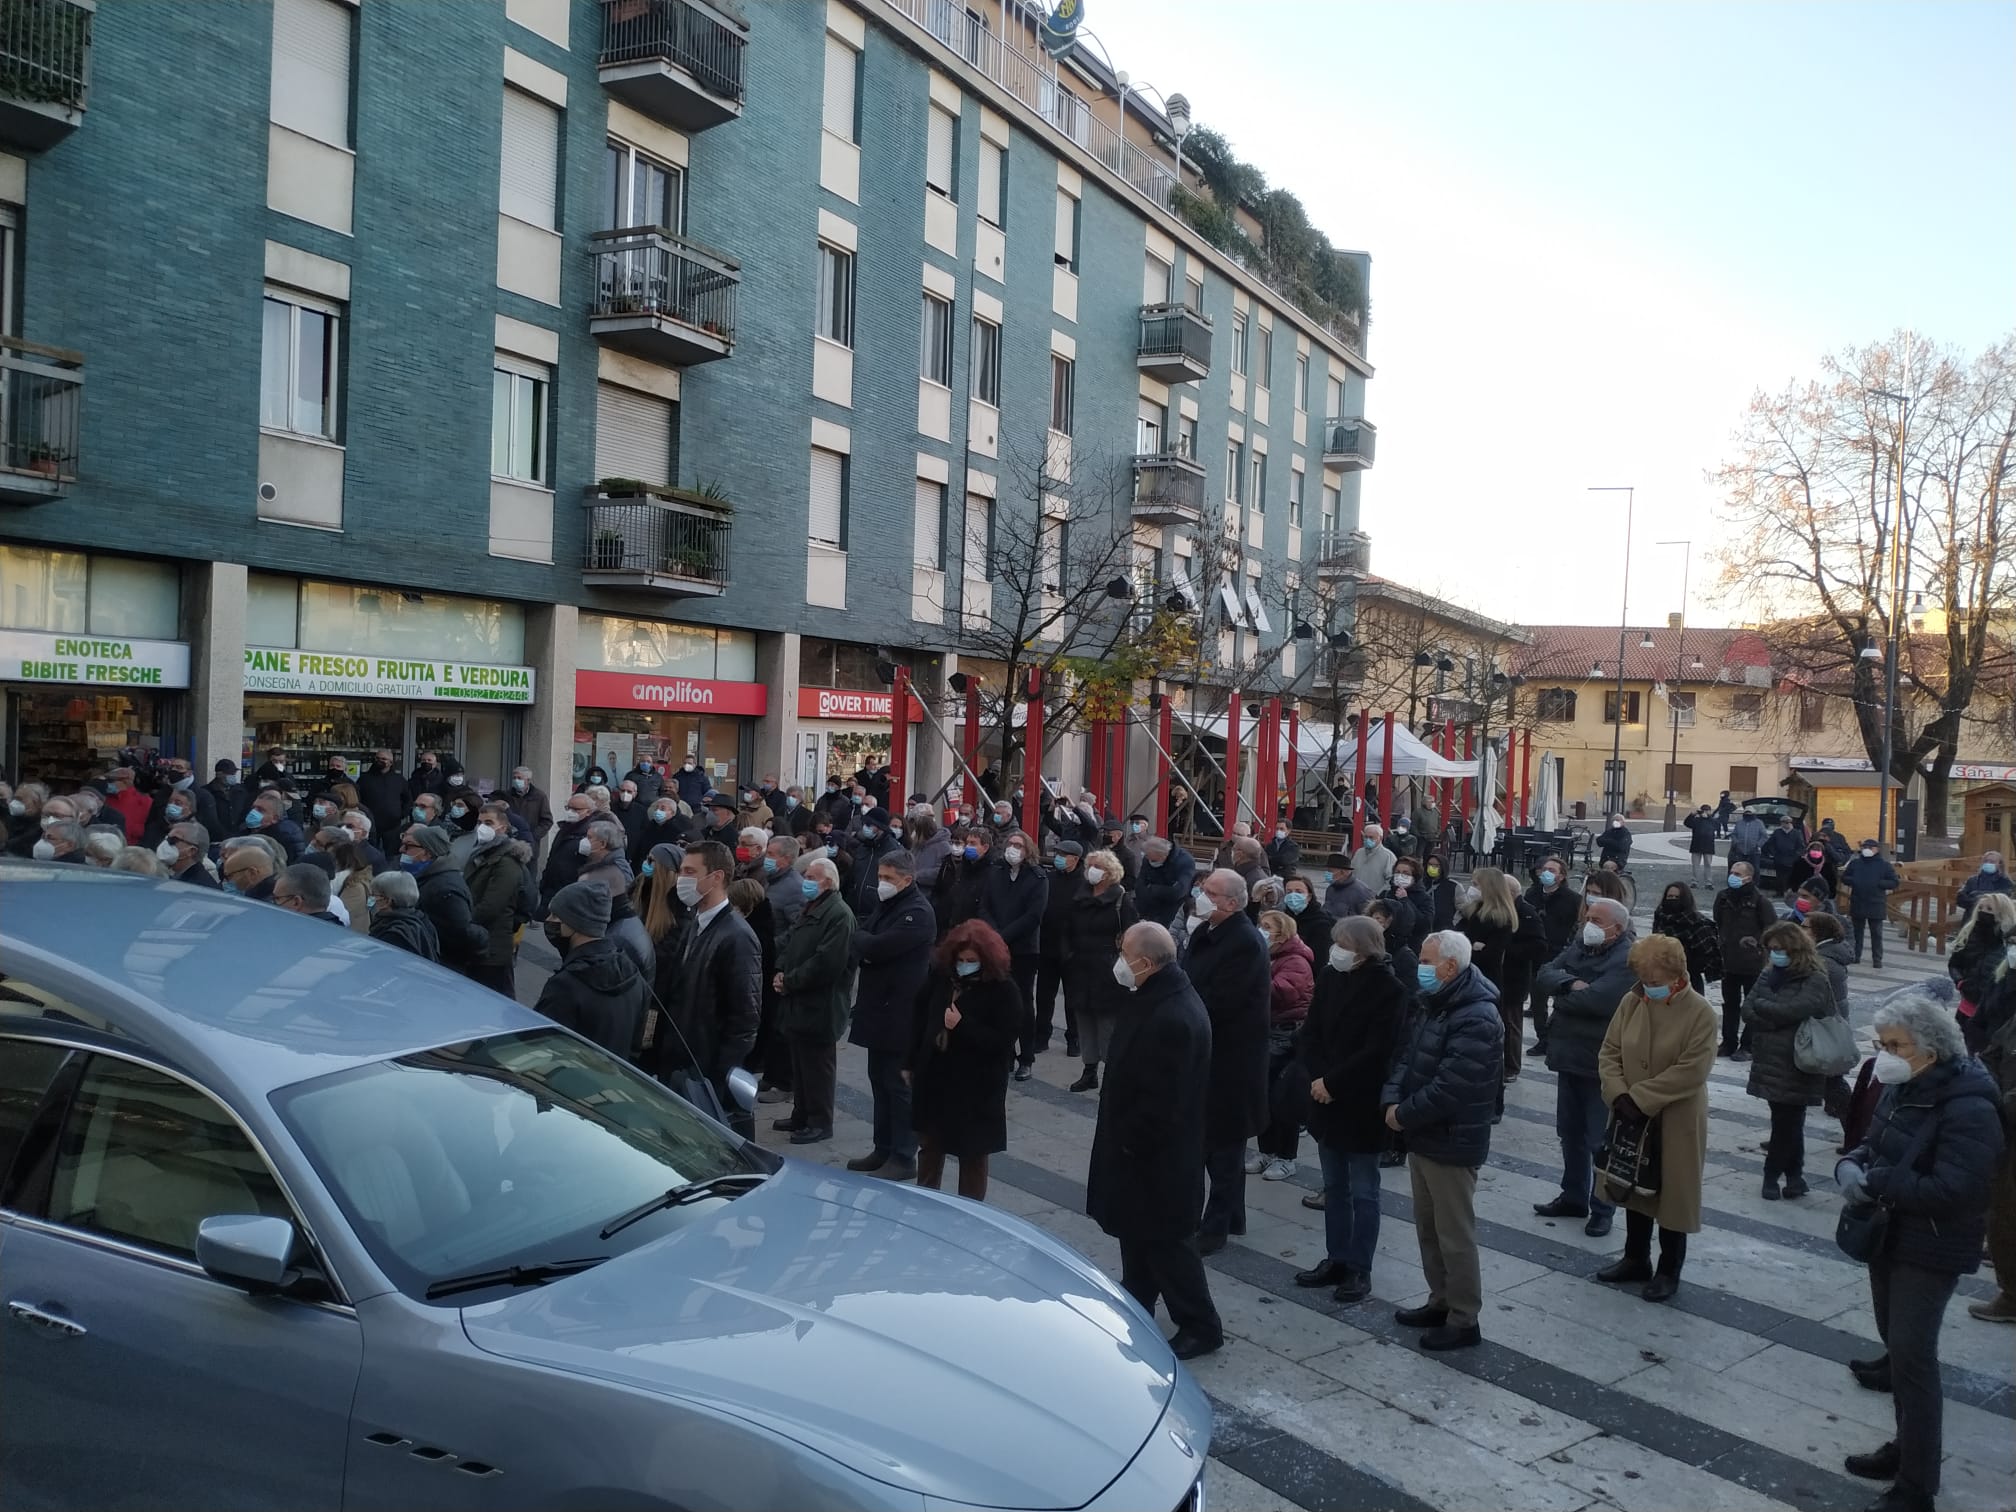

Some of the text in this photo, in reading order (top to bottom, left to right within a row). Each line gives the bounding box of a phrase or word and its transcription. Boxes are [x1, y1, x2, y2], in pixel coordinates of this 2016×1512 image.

[55, 639, 133, 660] ENOTECA
[21, 660, 162, 684] BIBITE FRESCHE
[244, 650, 529, 688] PANE FRESCO FRUTTA E VERDURA
[243, 674, 423, 696] CONSEGNA A DOMICILIO GRATUITA
[632, 681, 713, 707] amplifon
[820, 691, 892, 713] COVER TIME
[1955, 766, 1993, 778] Sara
